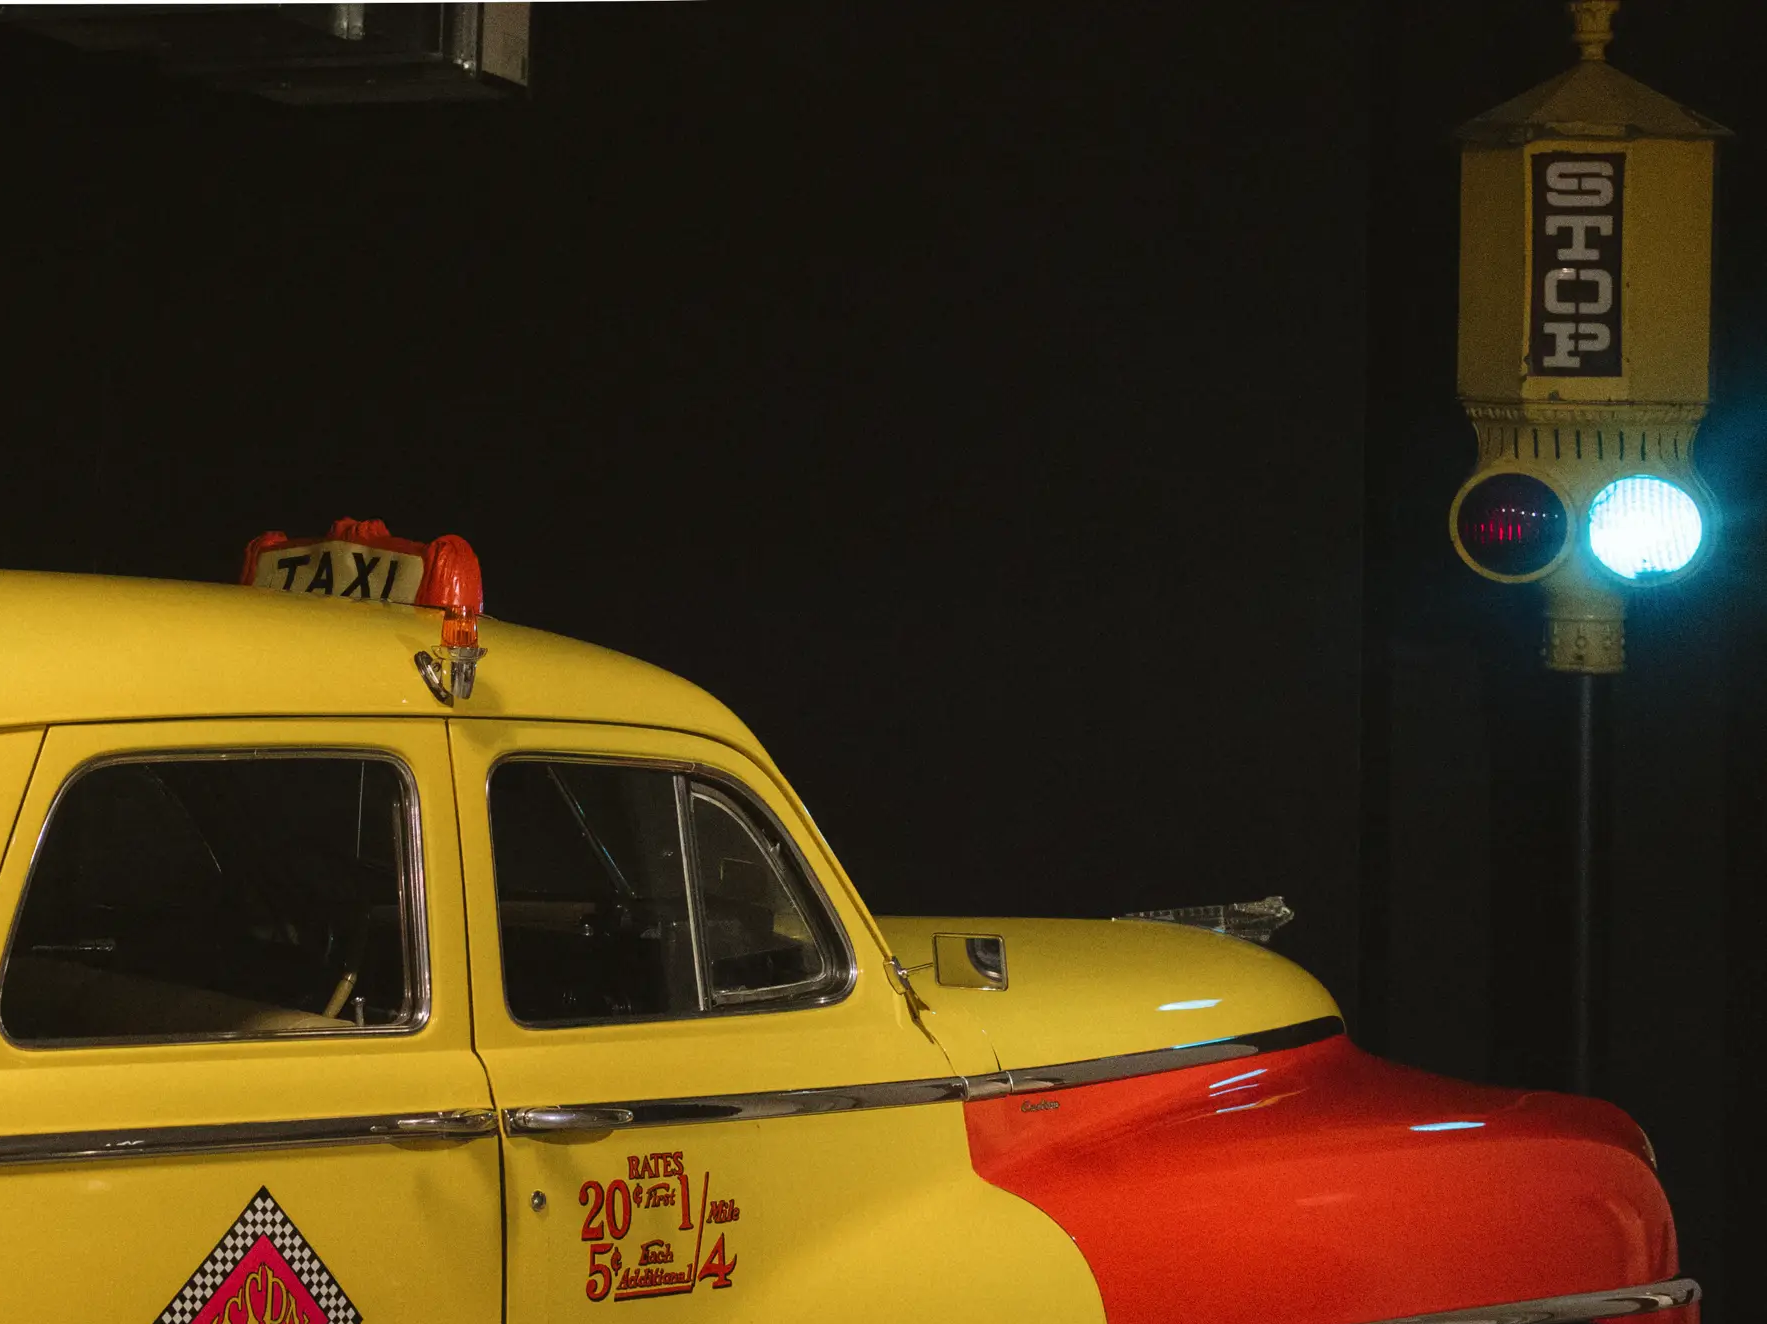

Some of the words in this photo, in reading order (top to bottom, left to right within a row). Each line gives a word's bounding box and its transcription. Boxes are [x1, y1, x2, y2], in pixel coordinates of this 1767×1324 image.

[1542, 161, 1615, 368] STOP
[277, 551, 399, 599] TAXI
[627, 1151, 684, 1180] RATES
[644, 1182, 676, 1209] First
[706, 1199, 740, 1224] Mile
[638, 1239, 674, 1266] Each
[616, 1264, 693, 1290] Additional
